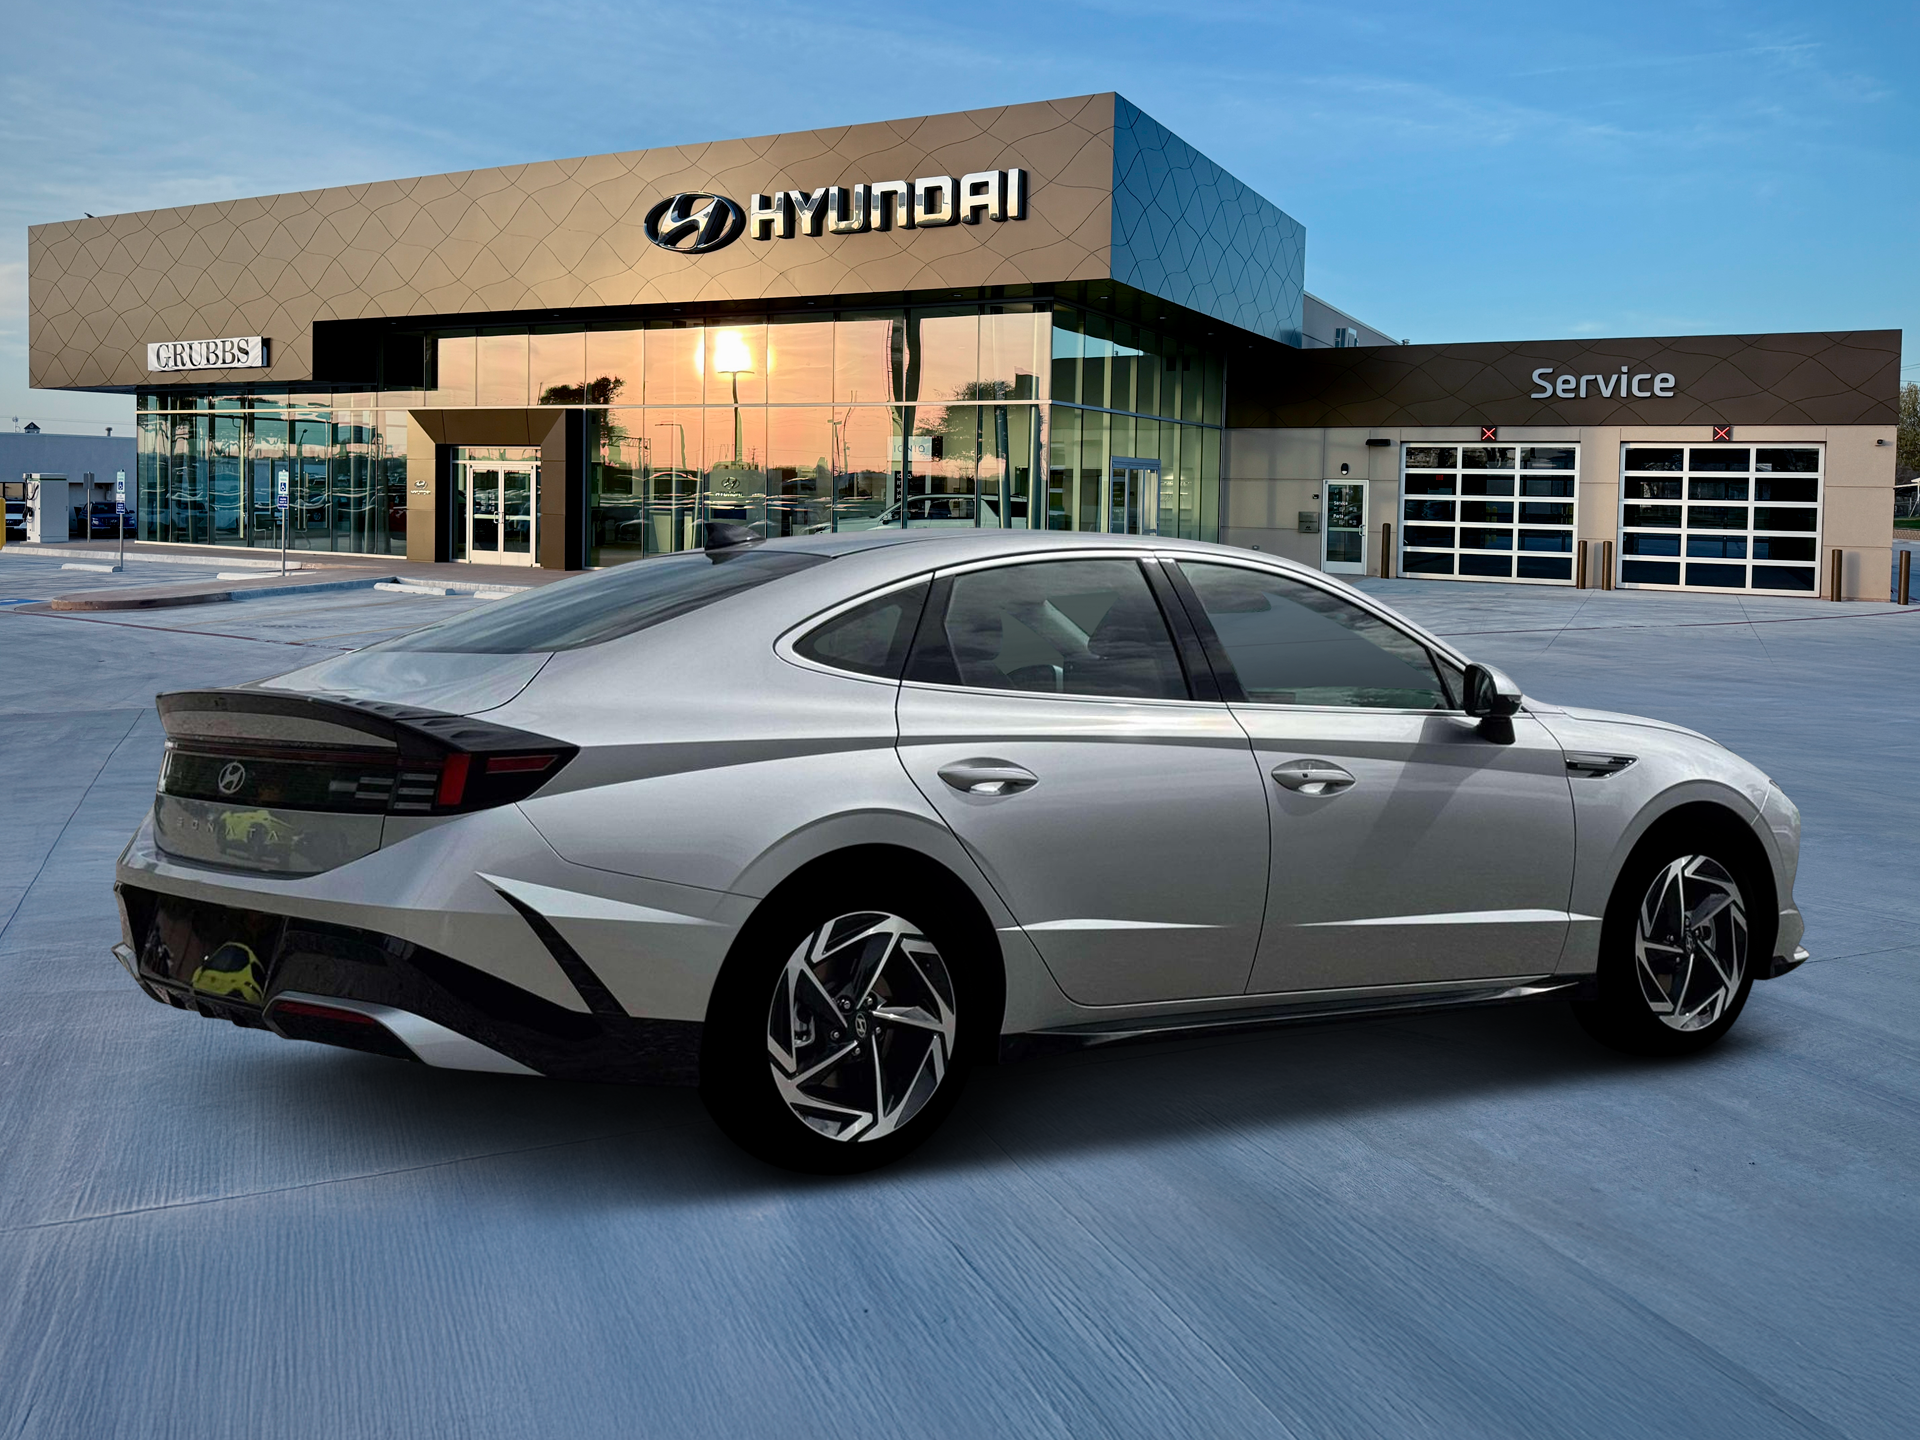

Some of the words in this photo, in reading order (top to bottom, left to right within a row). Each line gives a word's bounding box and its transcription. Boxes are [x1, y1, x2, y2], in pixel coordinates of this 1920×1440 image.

[750, 168, 1026, 240] HYUNDAI
[157, 339, 249, 368] GRUBBS
[1531, 366, 1675, 398] Service
[176, 816, 279, 842] SONATA
